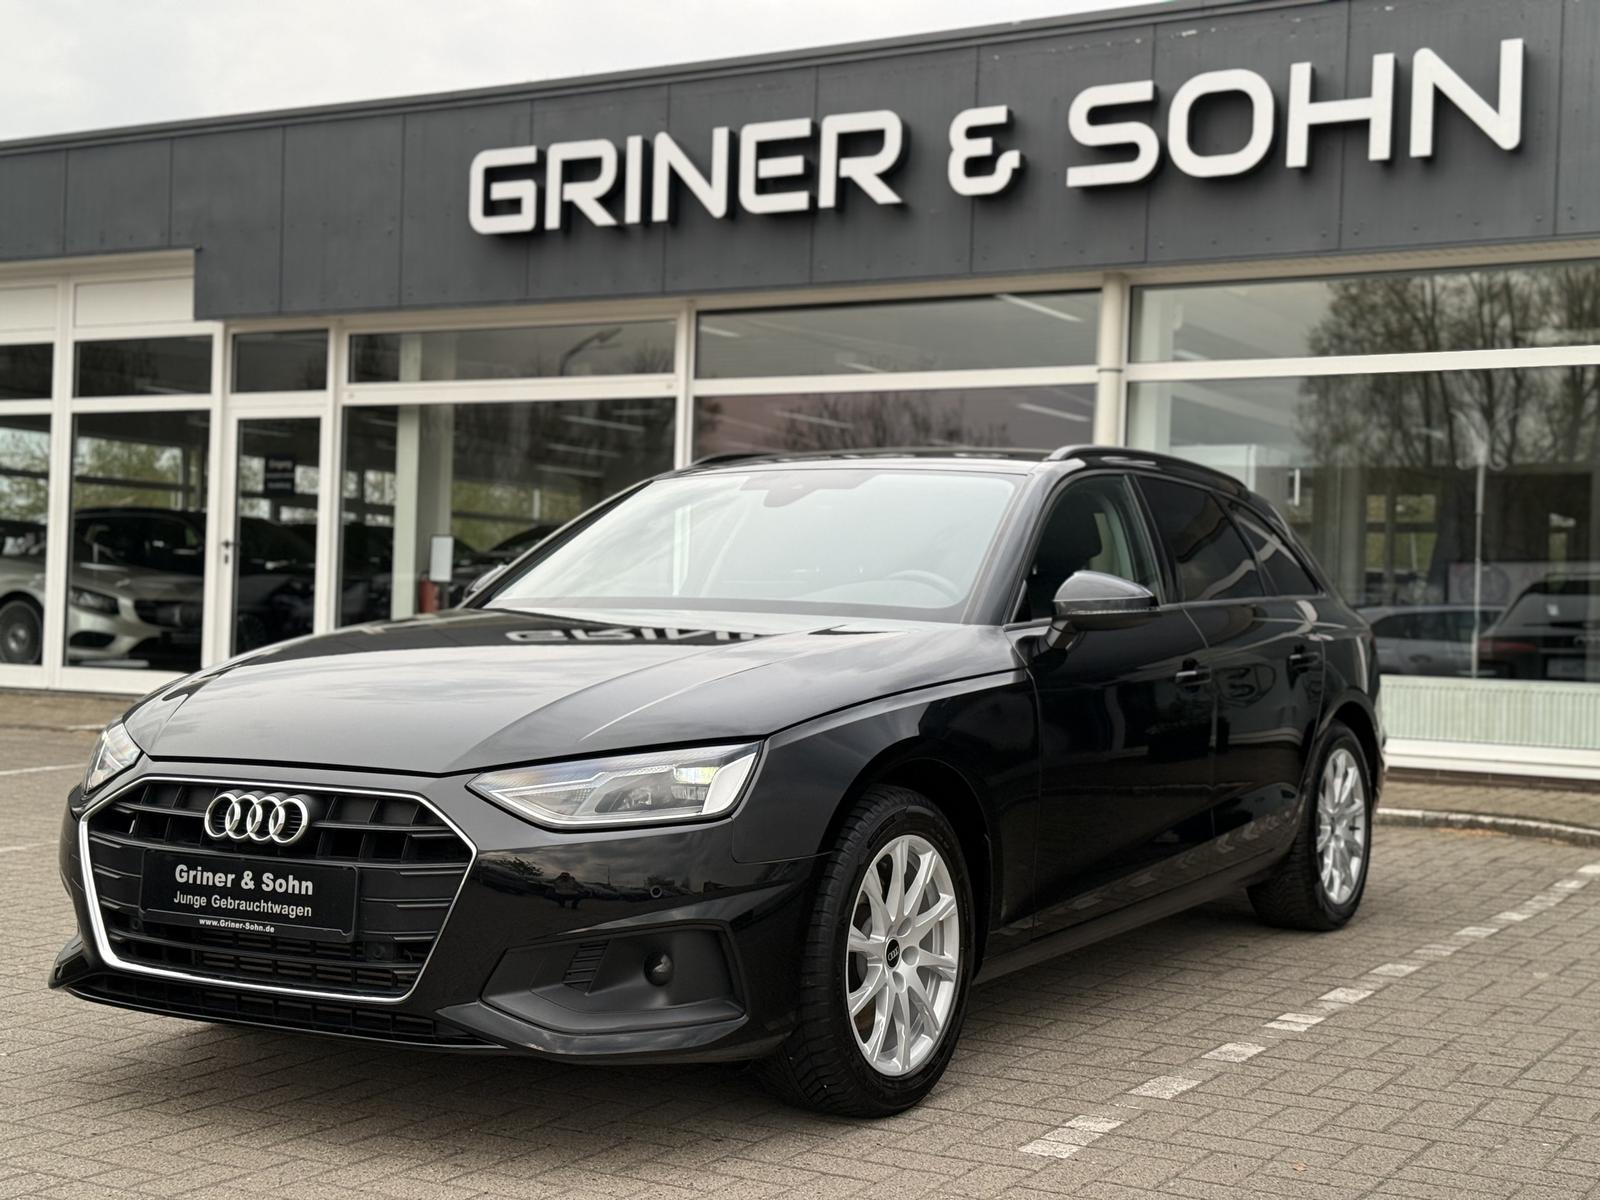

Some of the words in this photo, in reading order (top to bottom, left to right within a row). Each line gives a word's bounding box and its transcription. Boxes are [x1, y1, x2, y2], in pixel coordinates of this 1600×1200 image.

[469, 109, 904, 236] GRINER
[947, 104, 1021, 198] &
[1066, 38, 1525, 189] SOHN
[174, 864, 236, 888] Griner
[240, 870, 256, 890] &
[261, 872, 313, 896] Sohn
[173, 890, 207, 909] Junge
[211, 894, 312, 919] Gebrauchtwagen
[198, 918, 275, 933] www.Griner-Sohn.de
